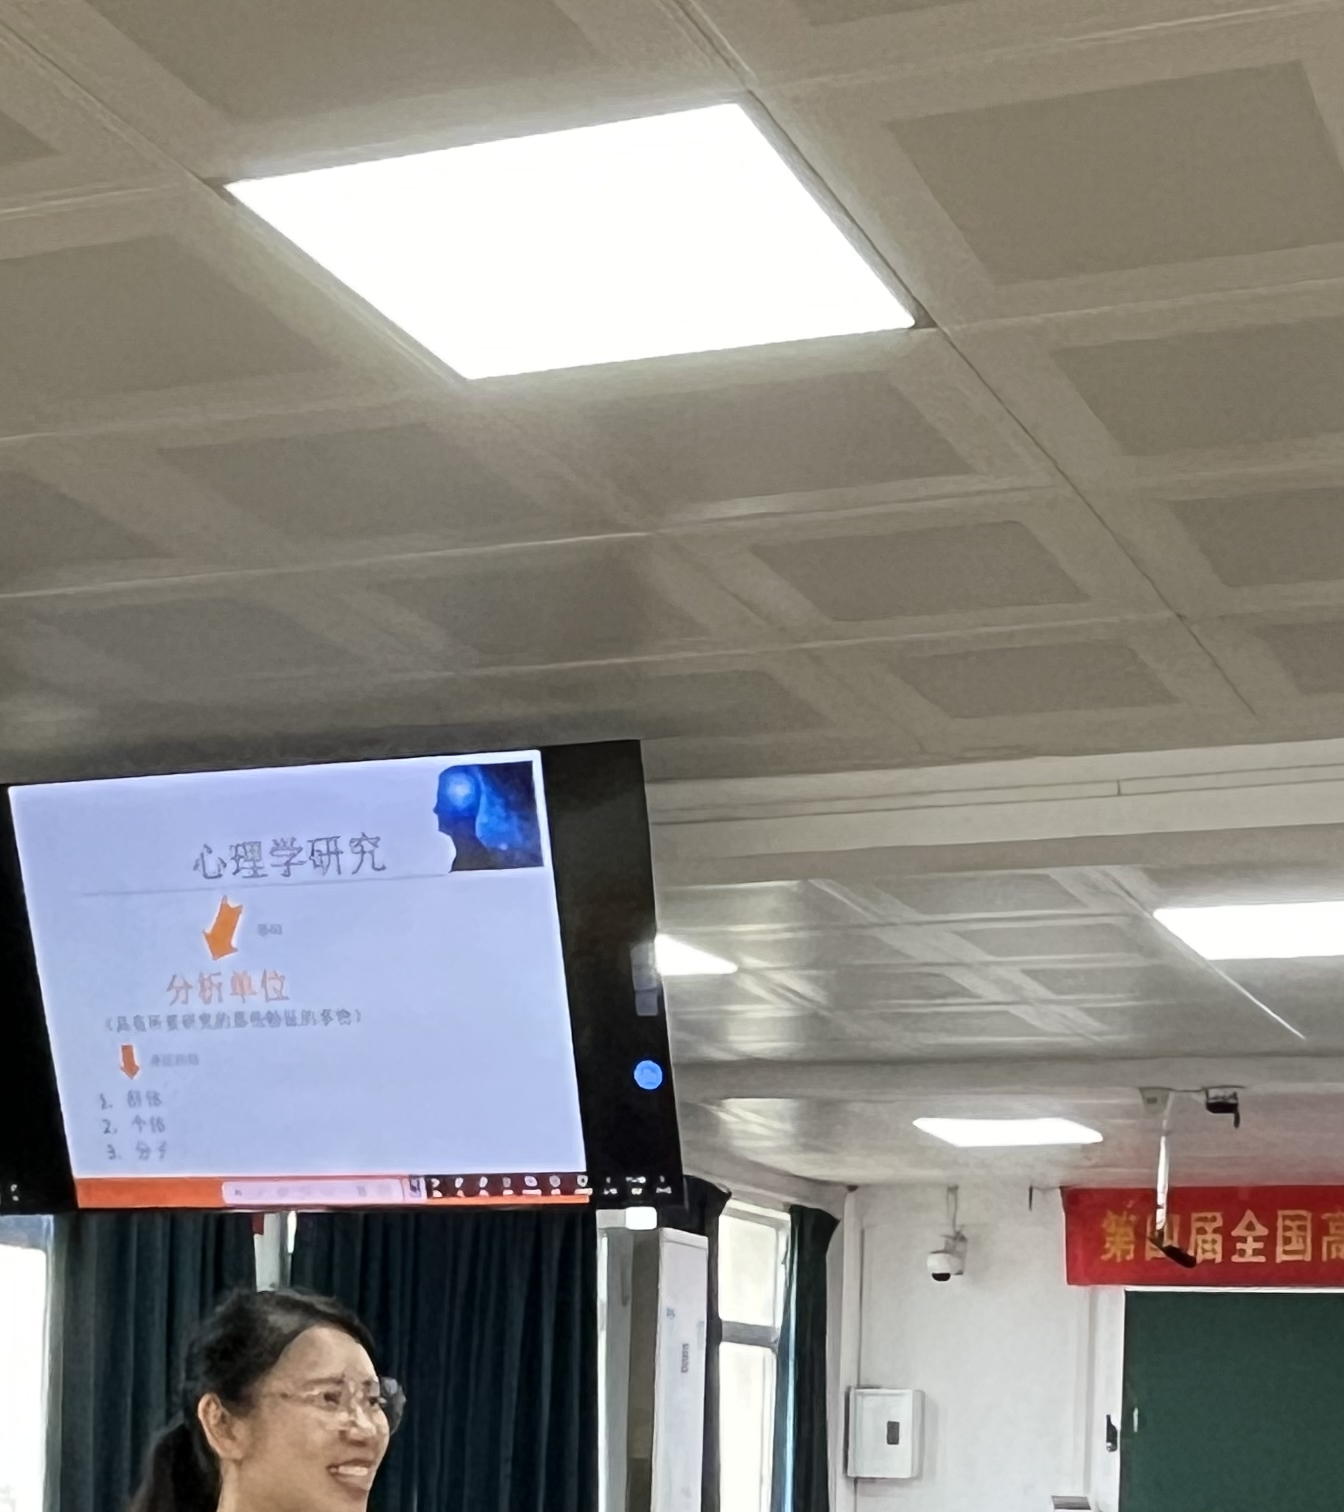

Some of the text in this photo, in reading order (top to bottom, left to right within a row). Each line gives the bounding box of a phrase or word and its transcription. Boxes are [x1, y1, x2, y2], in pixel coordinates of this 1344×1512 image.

[192, 831, 387, 880] 心理学研究
[166, 968, 291, 1006] 分析单位
